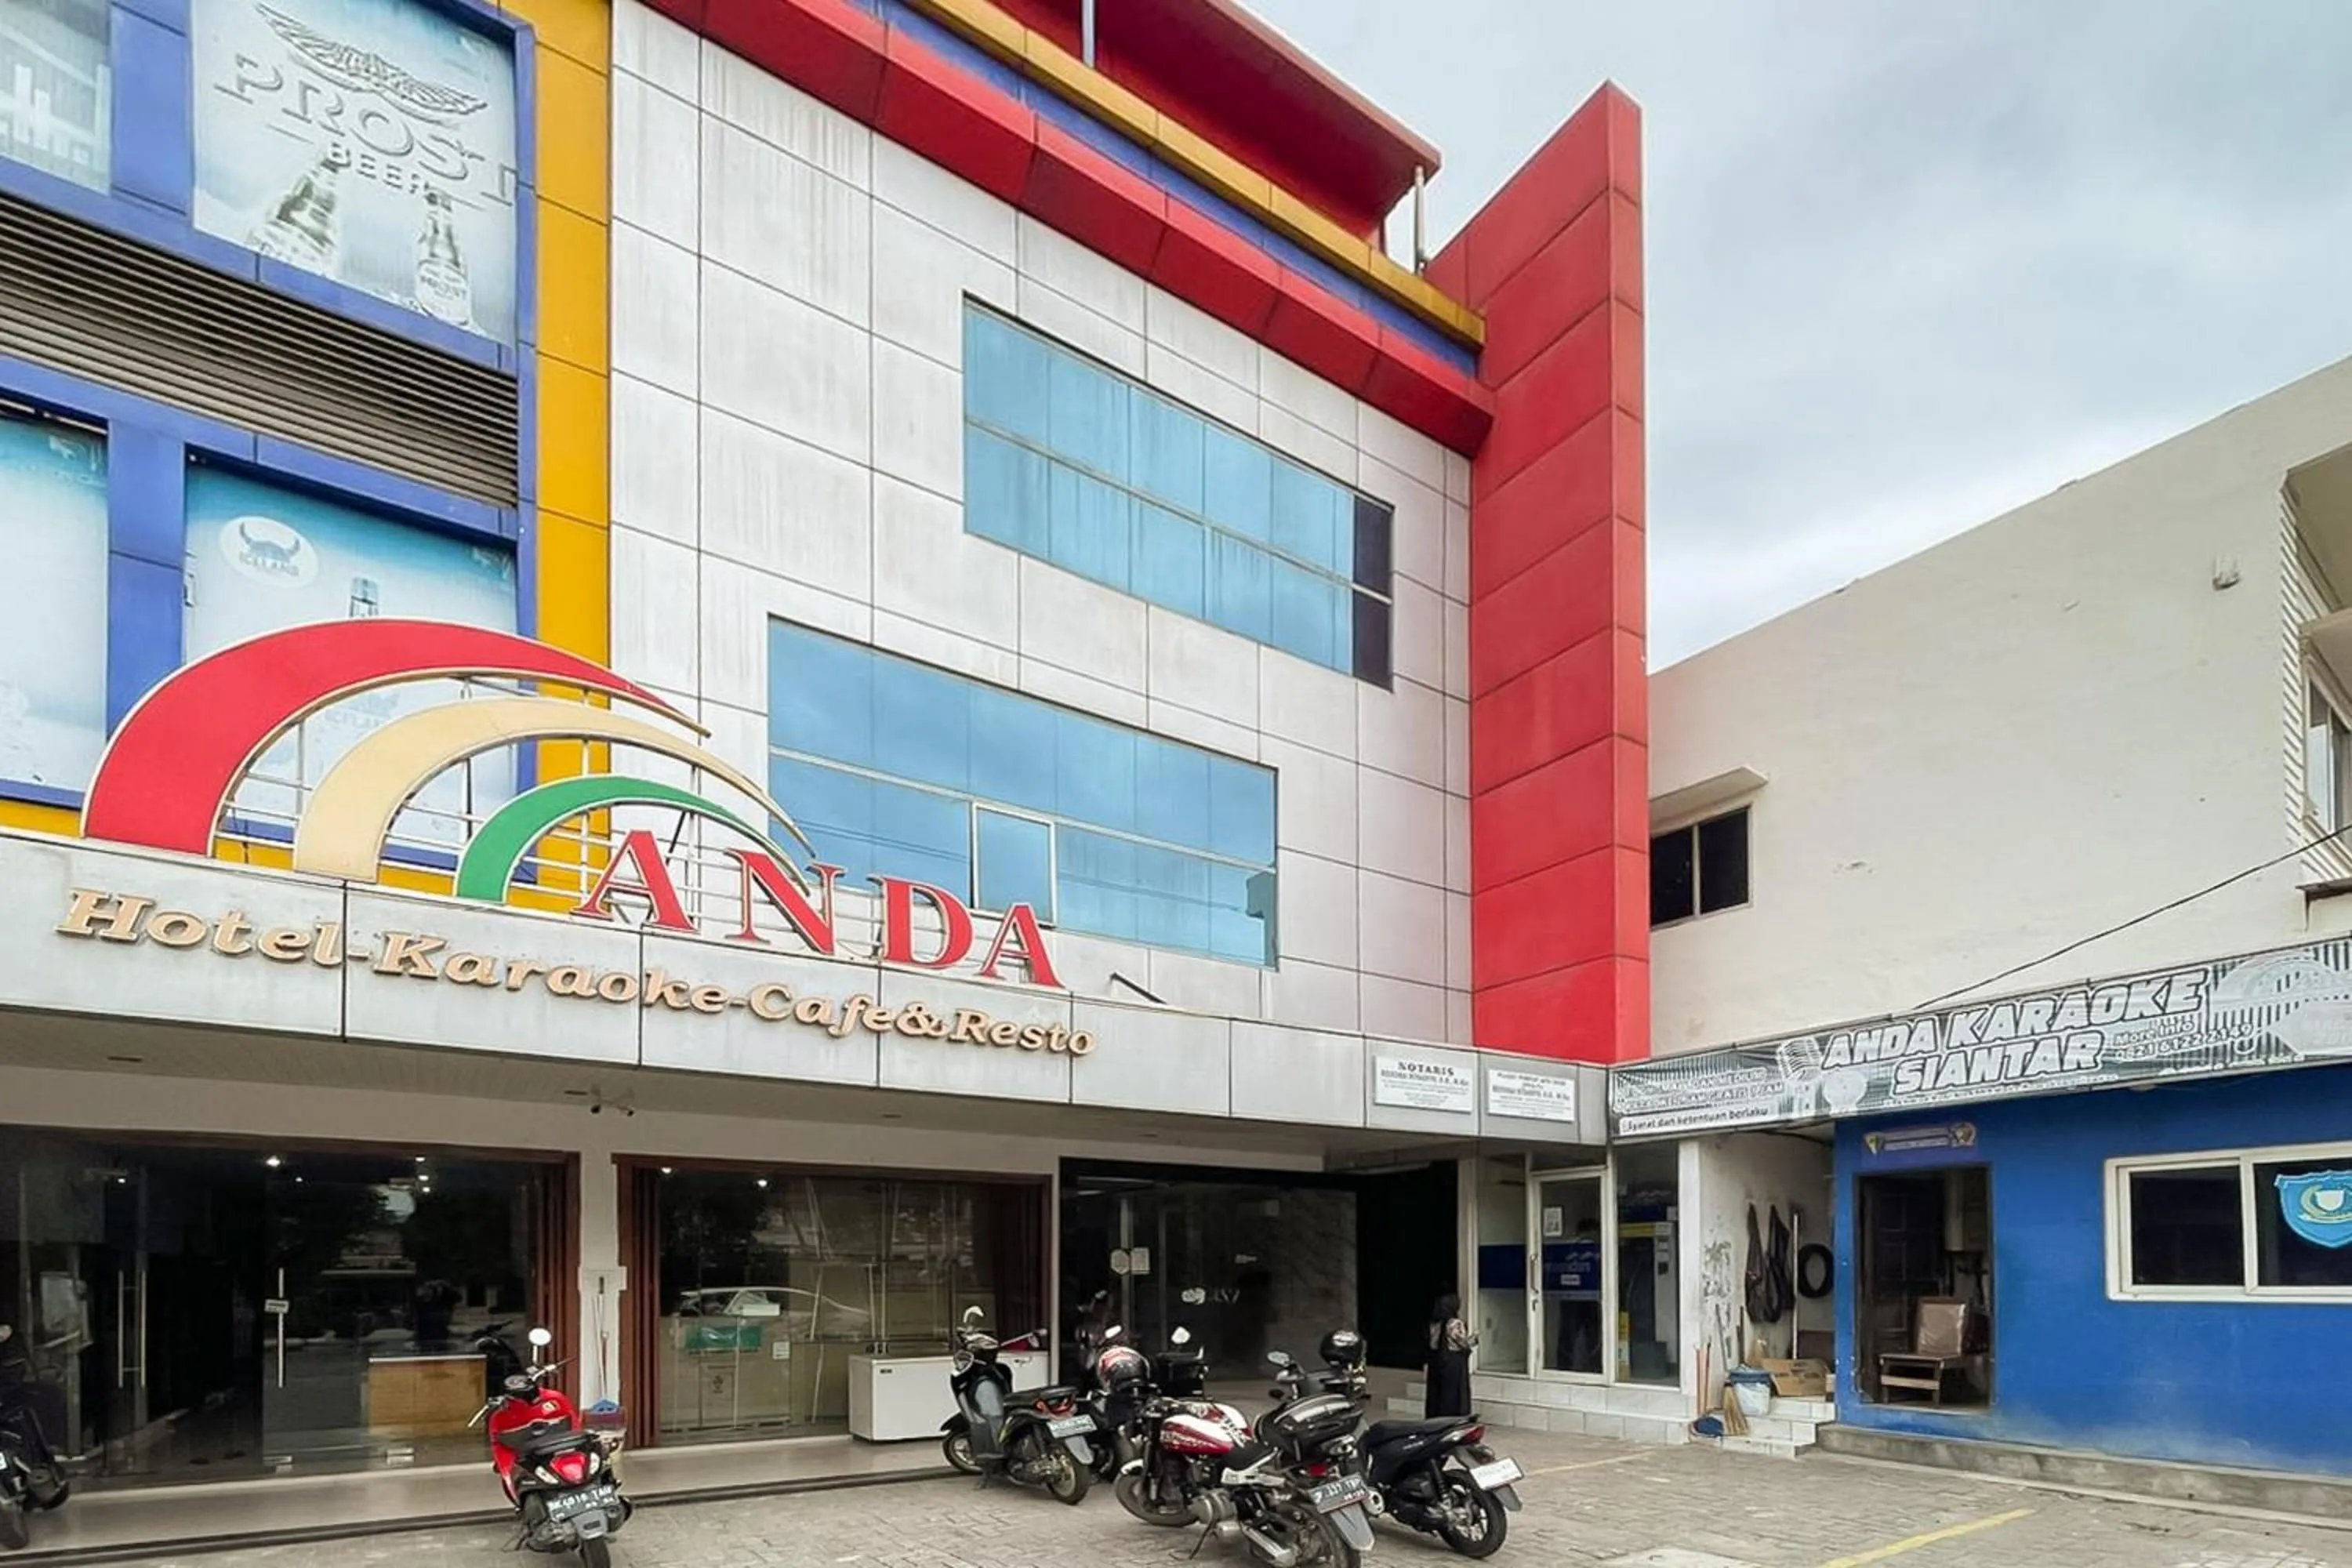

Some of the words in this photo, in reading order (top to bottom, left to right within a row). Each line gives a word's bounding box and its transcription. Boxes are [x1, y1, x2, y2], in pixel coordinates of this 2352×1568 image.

[572, 830, 1065, 988] ANDA
[1822, 1016, 1937, 1069] ANDA
[1946, 968, 2209, 1049] KARAOKE
[2115, 1029, 2156, 1046] More
[2160, 1022, 2194, 1036] Info
[1398, 1062, 1454, 1076] NOTARIS
[1893, 1029, 2104, 1095] SIANTAR
